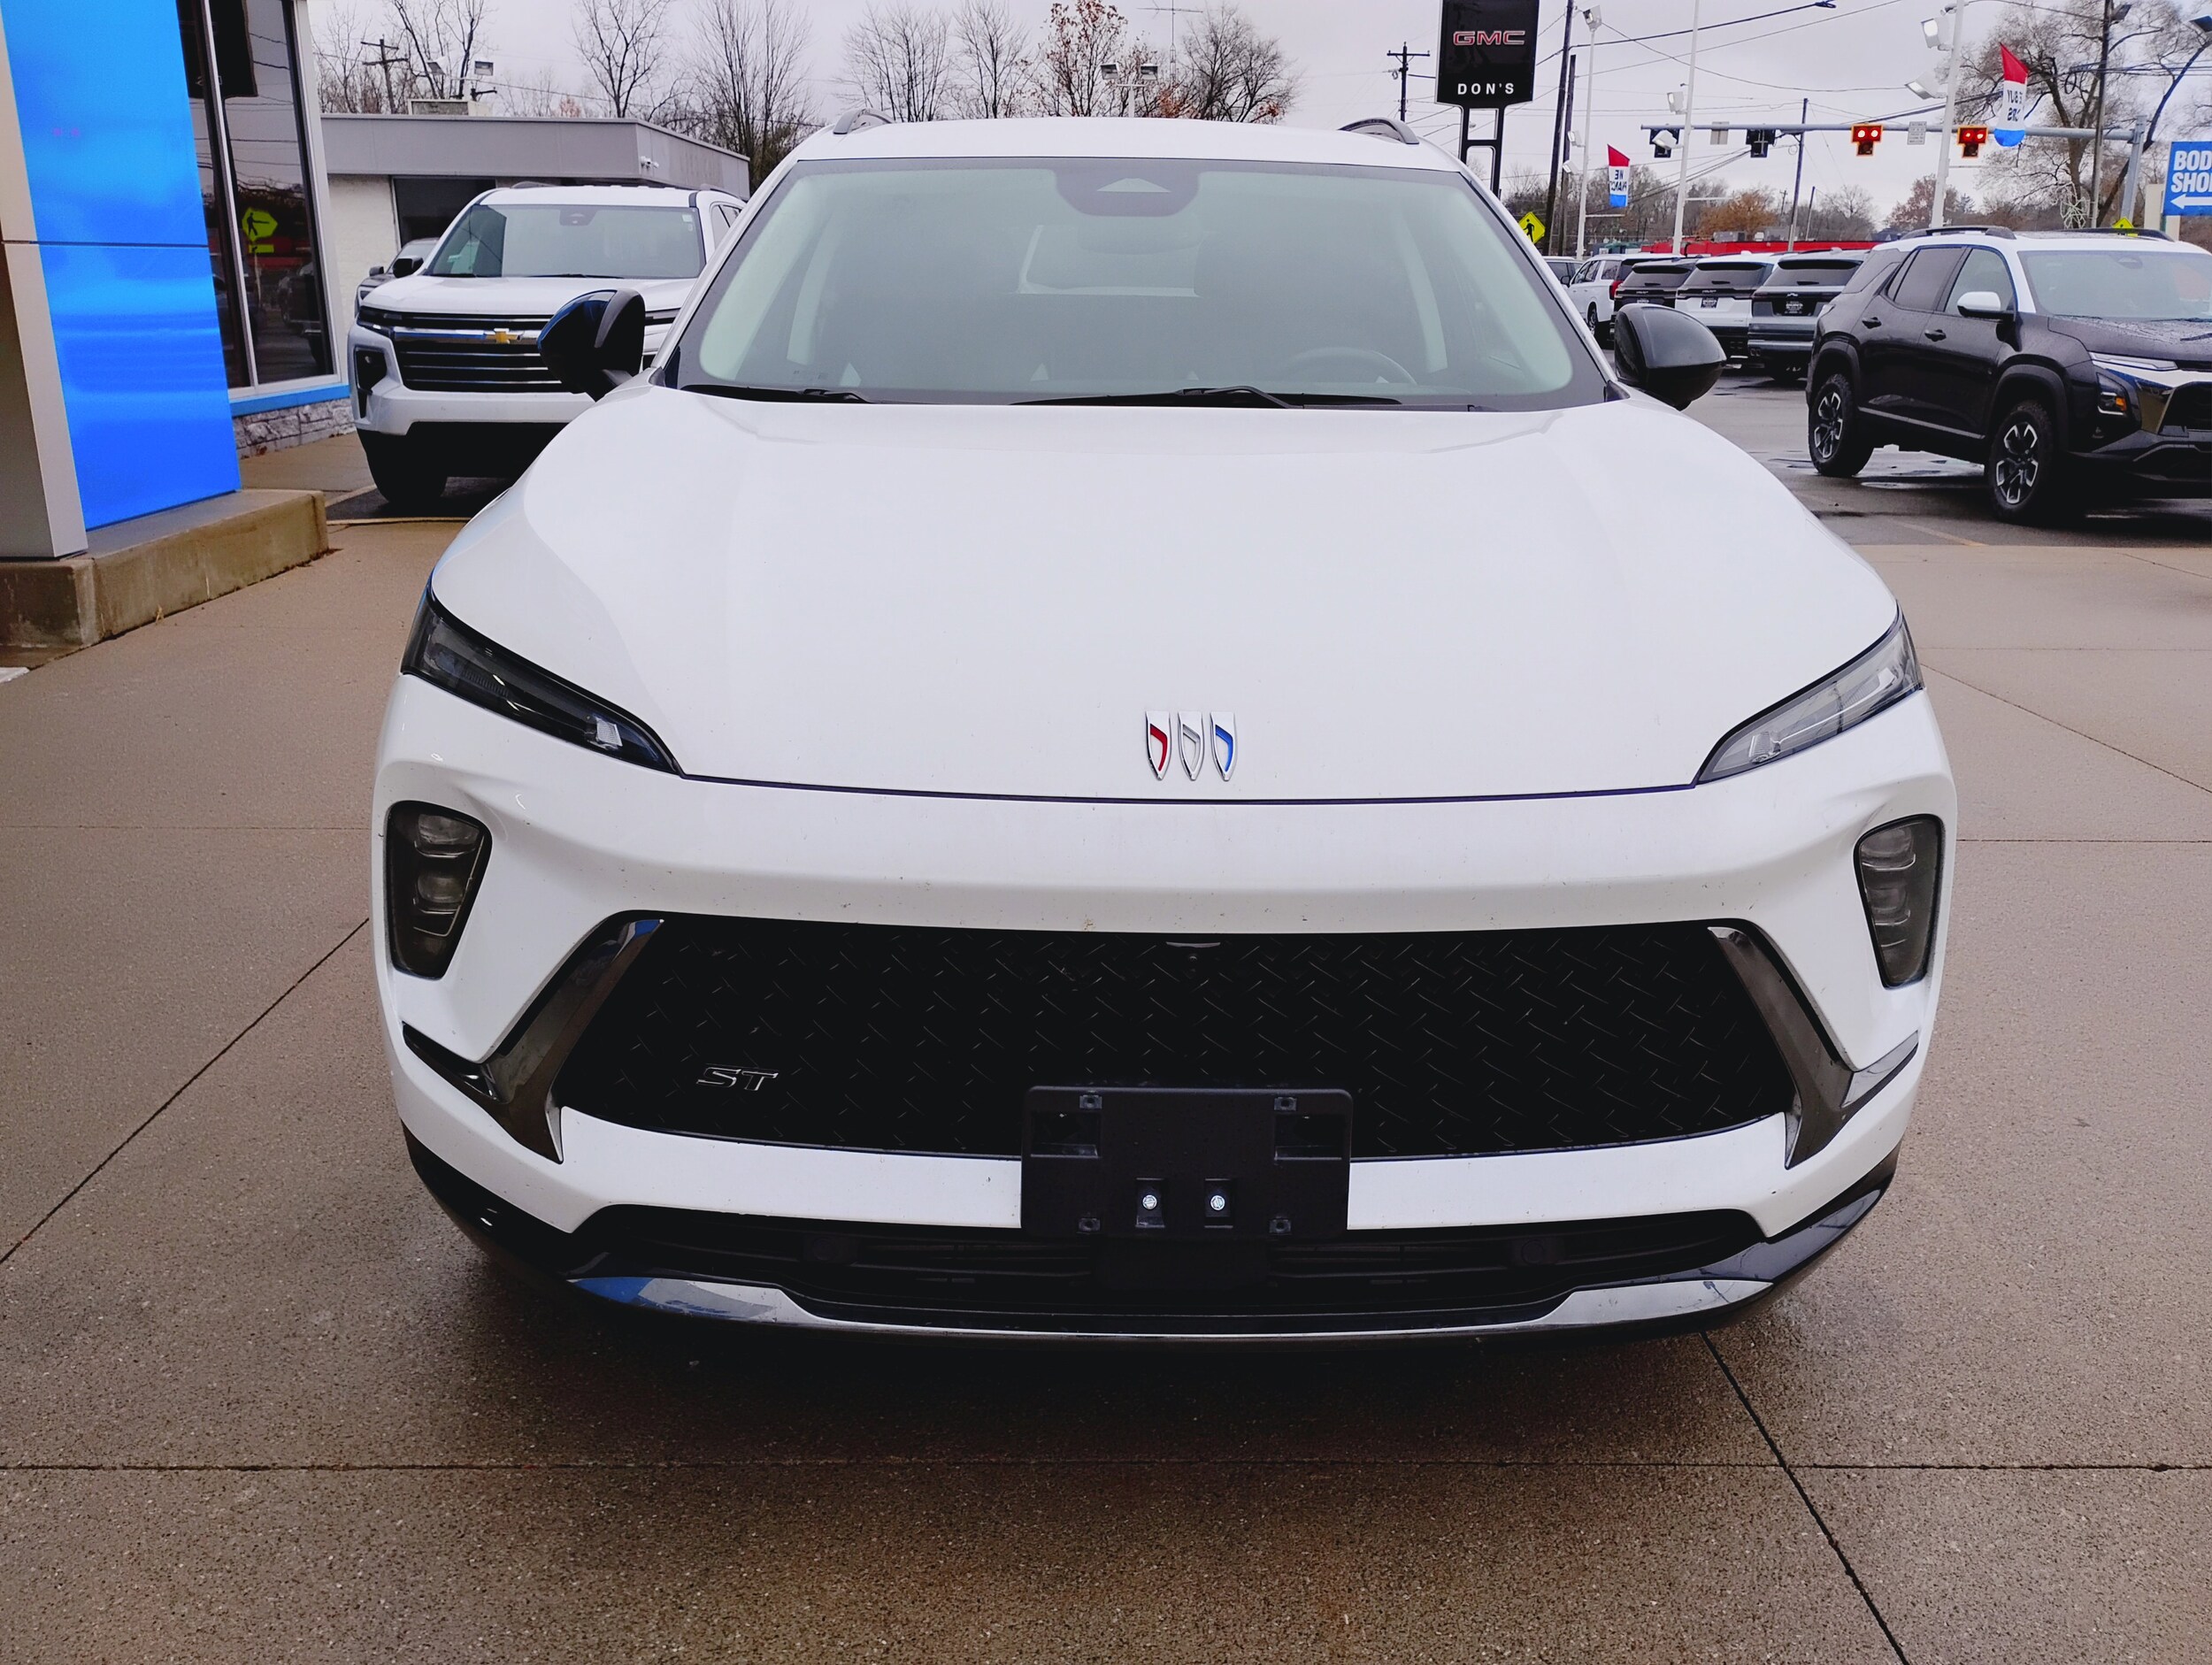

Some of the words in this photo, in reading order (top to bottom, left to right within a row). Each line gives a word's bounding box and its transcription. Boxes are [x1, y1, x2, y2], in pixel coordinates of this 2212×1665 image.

[1453, 30, 1525, 46] GMC
[1457, 82, 1514, 95] DON'S
[2173, 150, 2212, 171] BOD
[2170, 172, 2212, 193] SHO
[695, 1063, 779, 1091] ST
